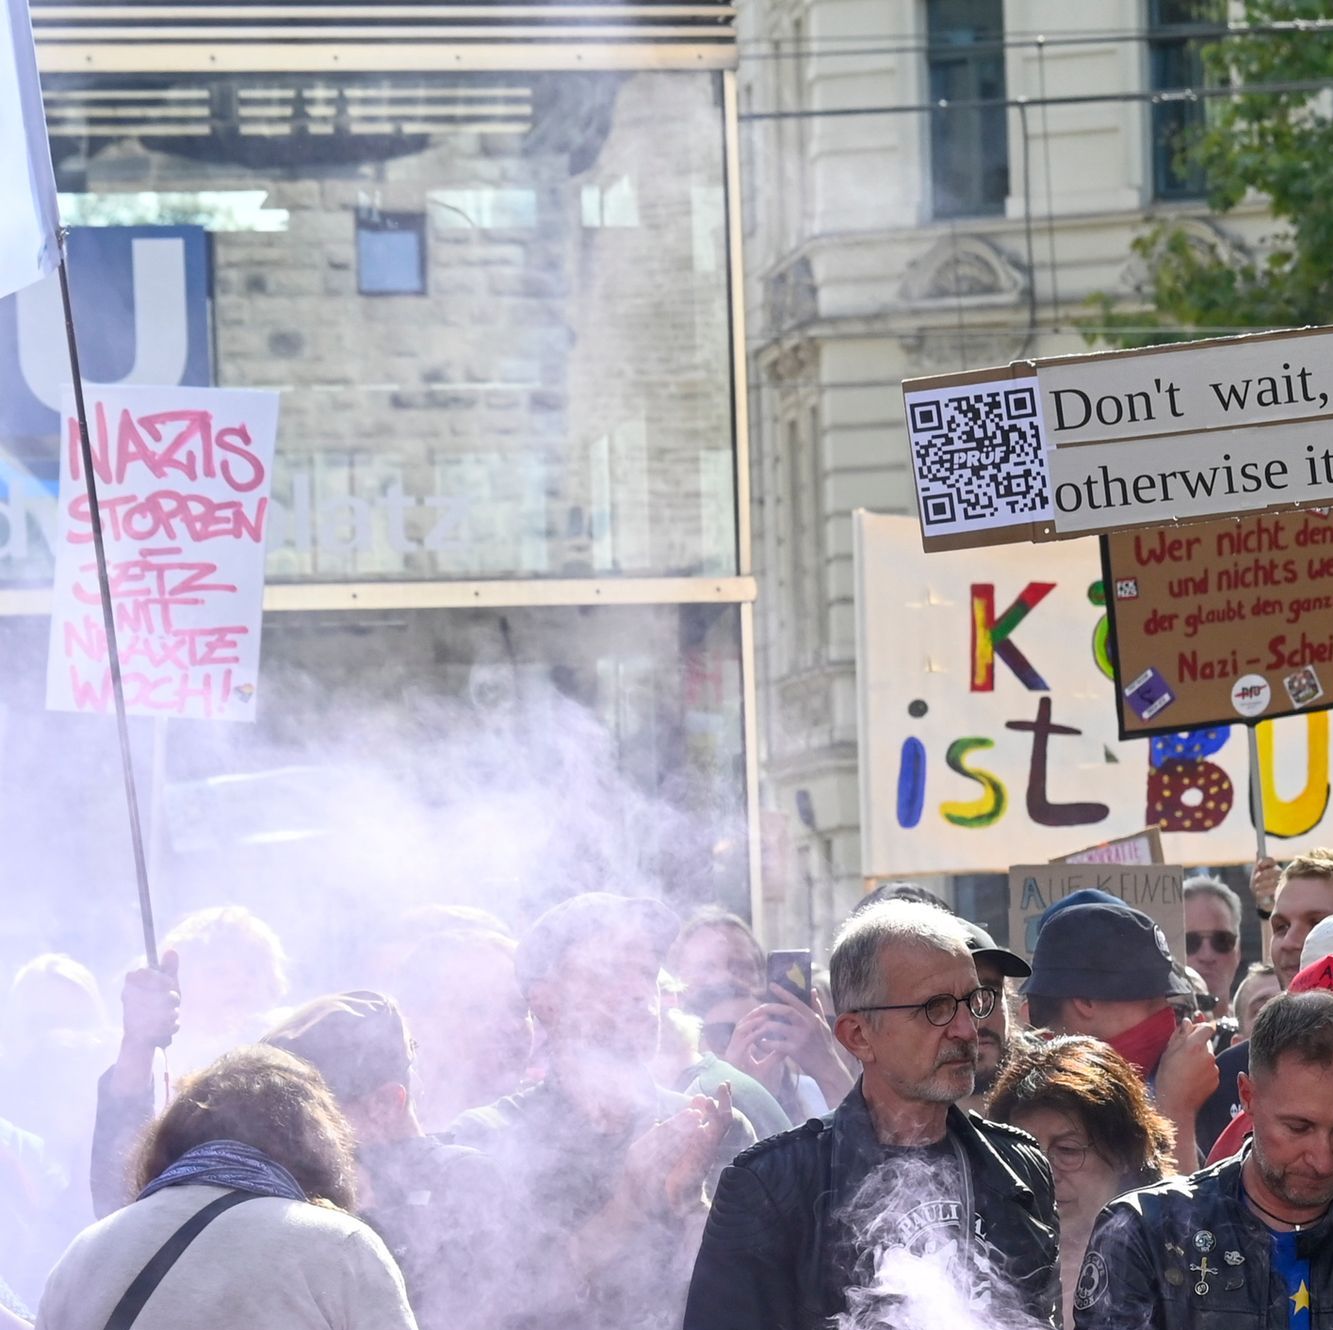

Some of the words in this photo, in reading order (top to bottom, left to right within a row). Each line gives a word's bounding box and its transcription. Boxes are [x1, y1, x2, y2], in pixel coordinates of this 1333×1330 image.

[1049, 377, 1184, 432] Don't
[1209, 362, 1329, 411] wait,
[68, 401, 266, 493] NAZIS
[952, 446, 1007, 469] PRÜF
[1055, 454, 1289, 514] otherwise
[66, 490, 269, 544] STOPPEN
[1133, 531, 1201, 568] Wer
[1216, 518, 1288, 556] nicht
[1168, 568, 1209, 599] und
[1216, 557, 1298, 593] nichts
[1143, 609, 1180, 636] der
[1183, 602, 1247, 638] glaubt
[1251, 595, 1284, 619] den
[896, 696, 1110, 829] ist
[898, 1203, 961, 1239] PAULI
